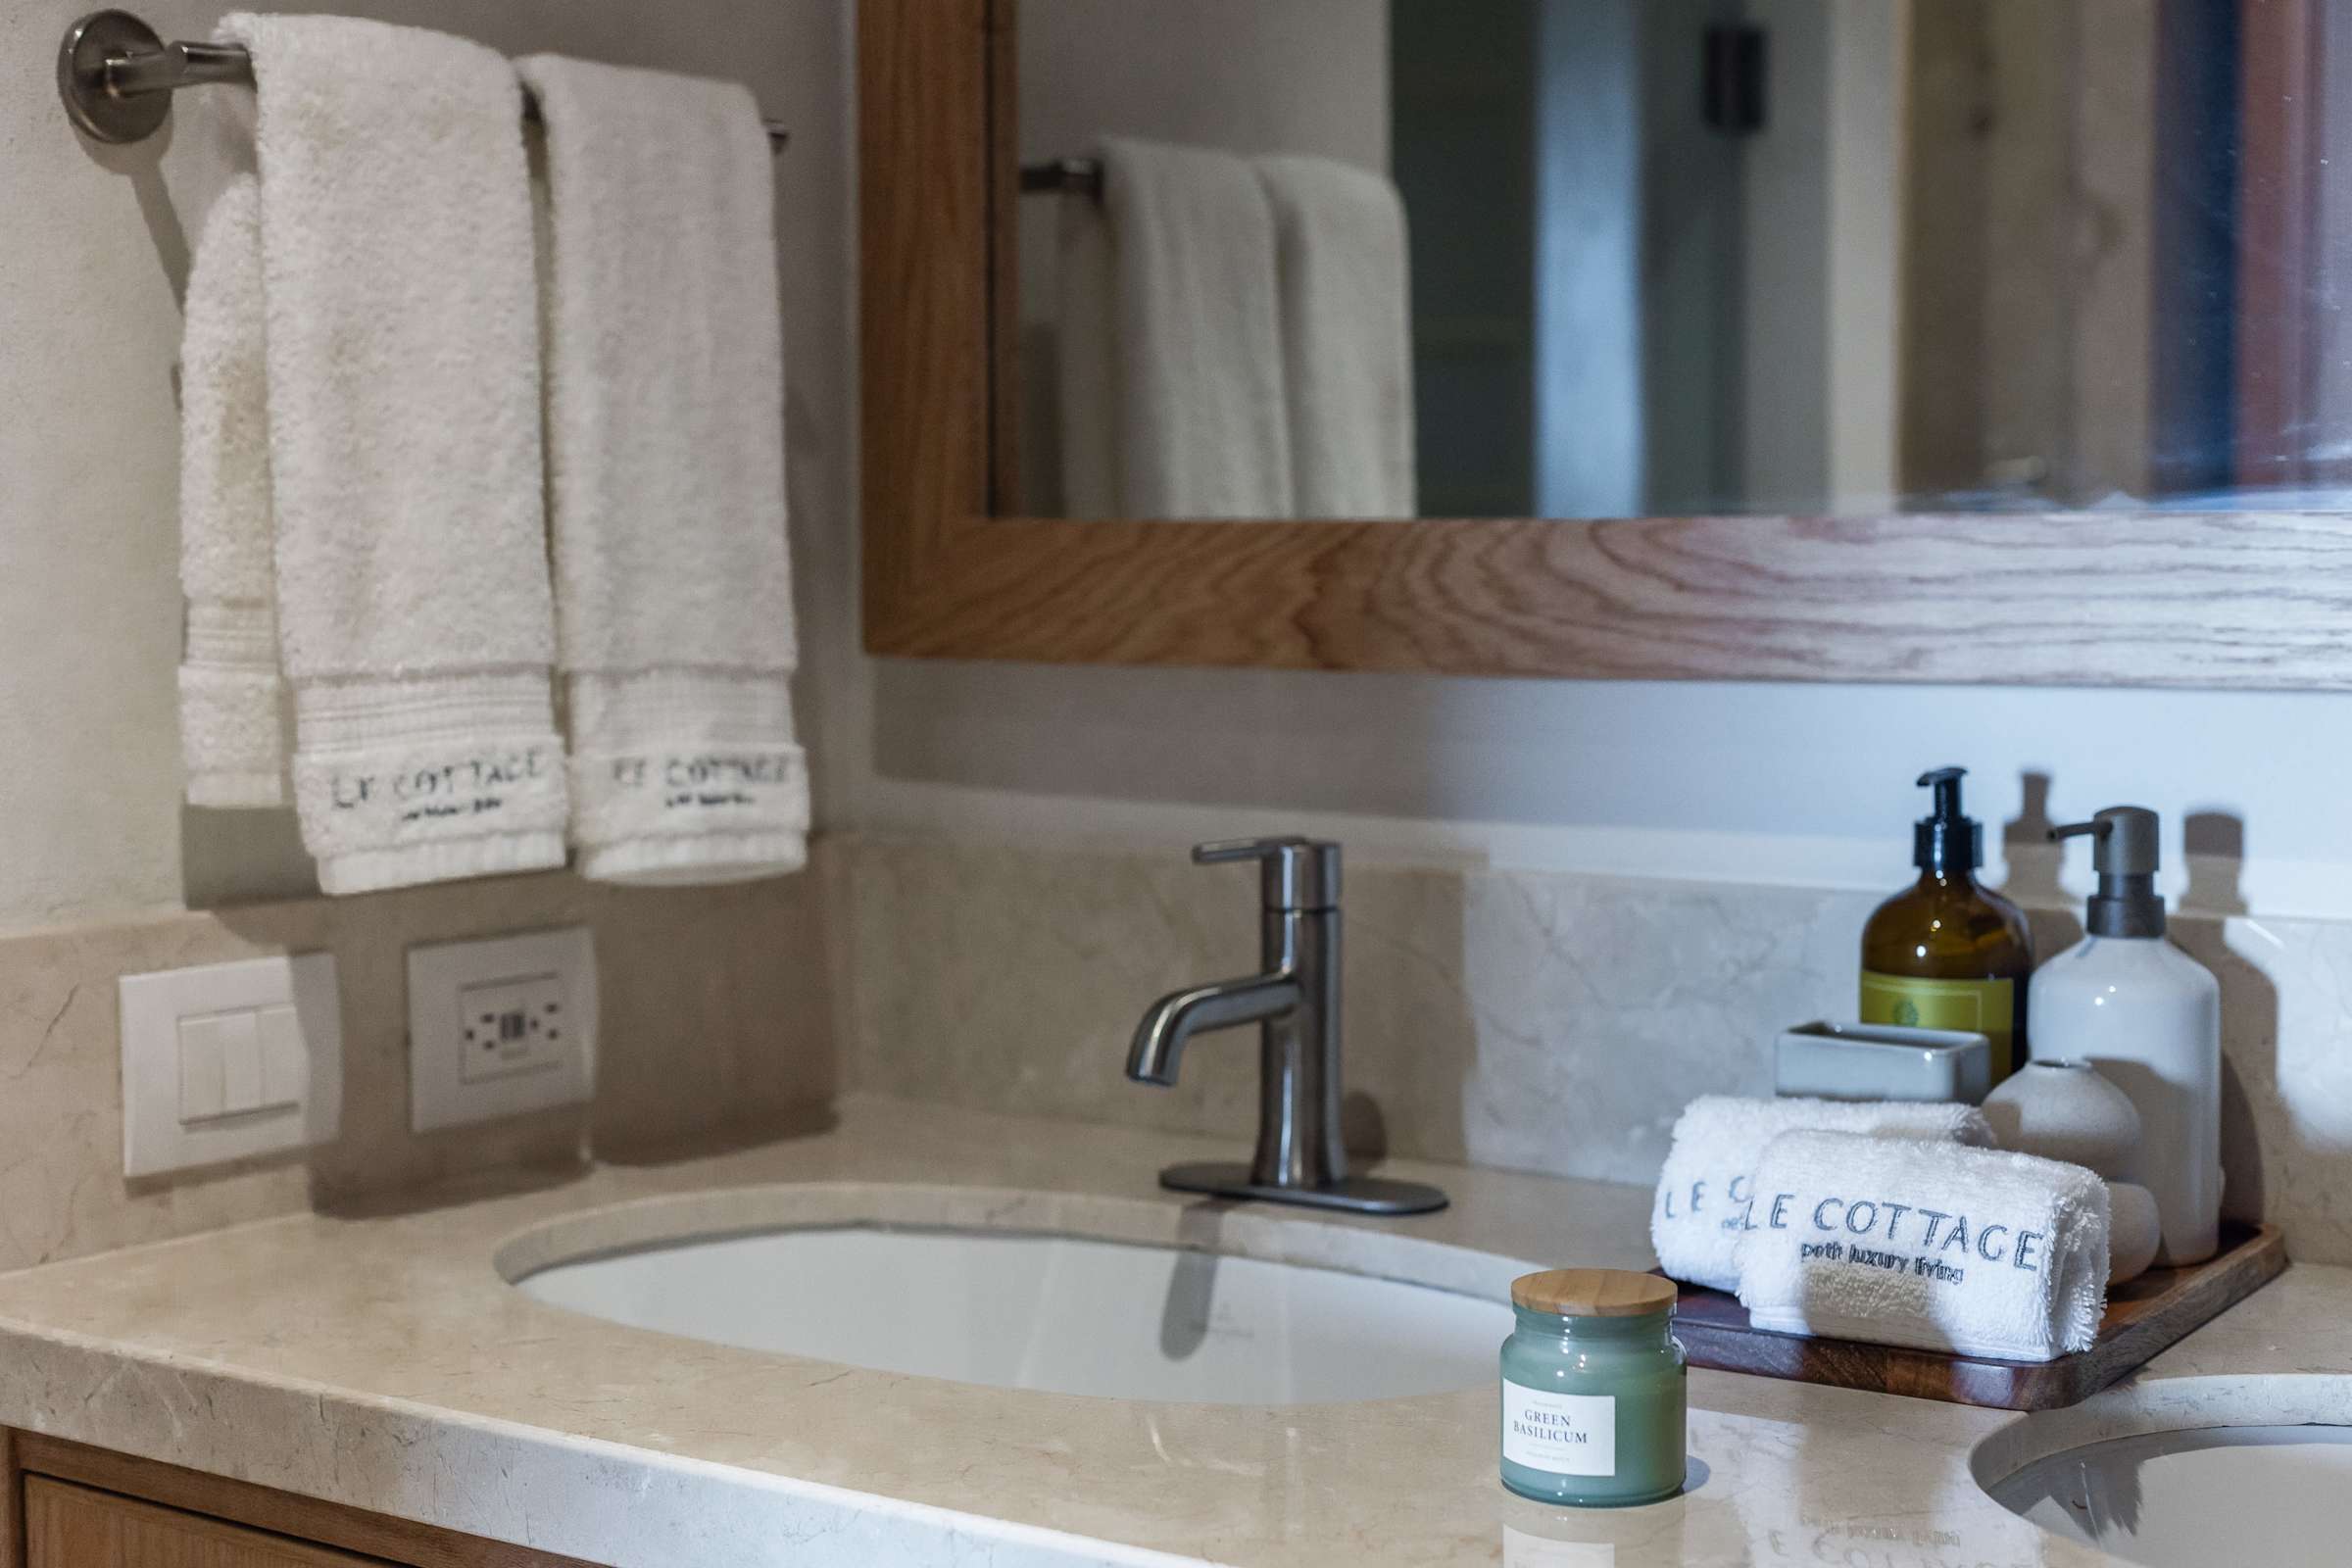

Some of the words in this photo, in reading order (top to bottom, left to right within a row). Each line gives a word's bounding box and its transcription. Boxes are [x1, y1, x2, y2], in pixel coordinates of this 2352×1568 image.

[1744, 1194, 1795, 1230] LE
[1813, 1197, 2044, 1272] COTTAGE
[1848, 1243, 1909, 1274] luxury
[1914, 1256, 1964, 1286] living
[1513, 1420, 1588, 1444] BASILICUM
[1524, 1409, 1571, 1427] GREEN
